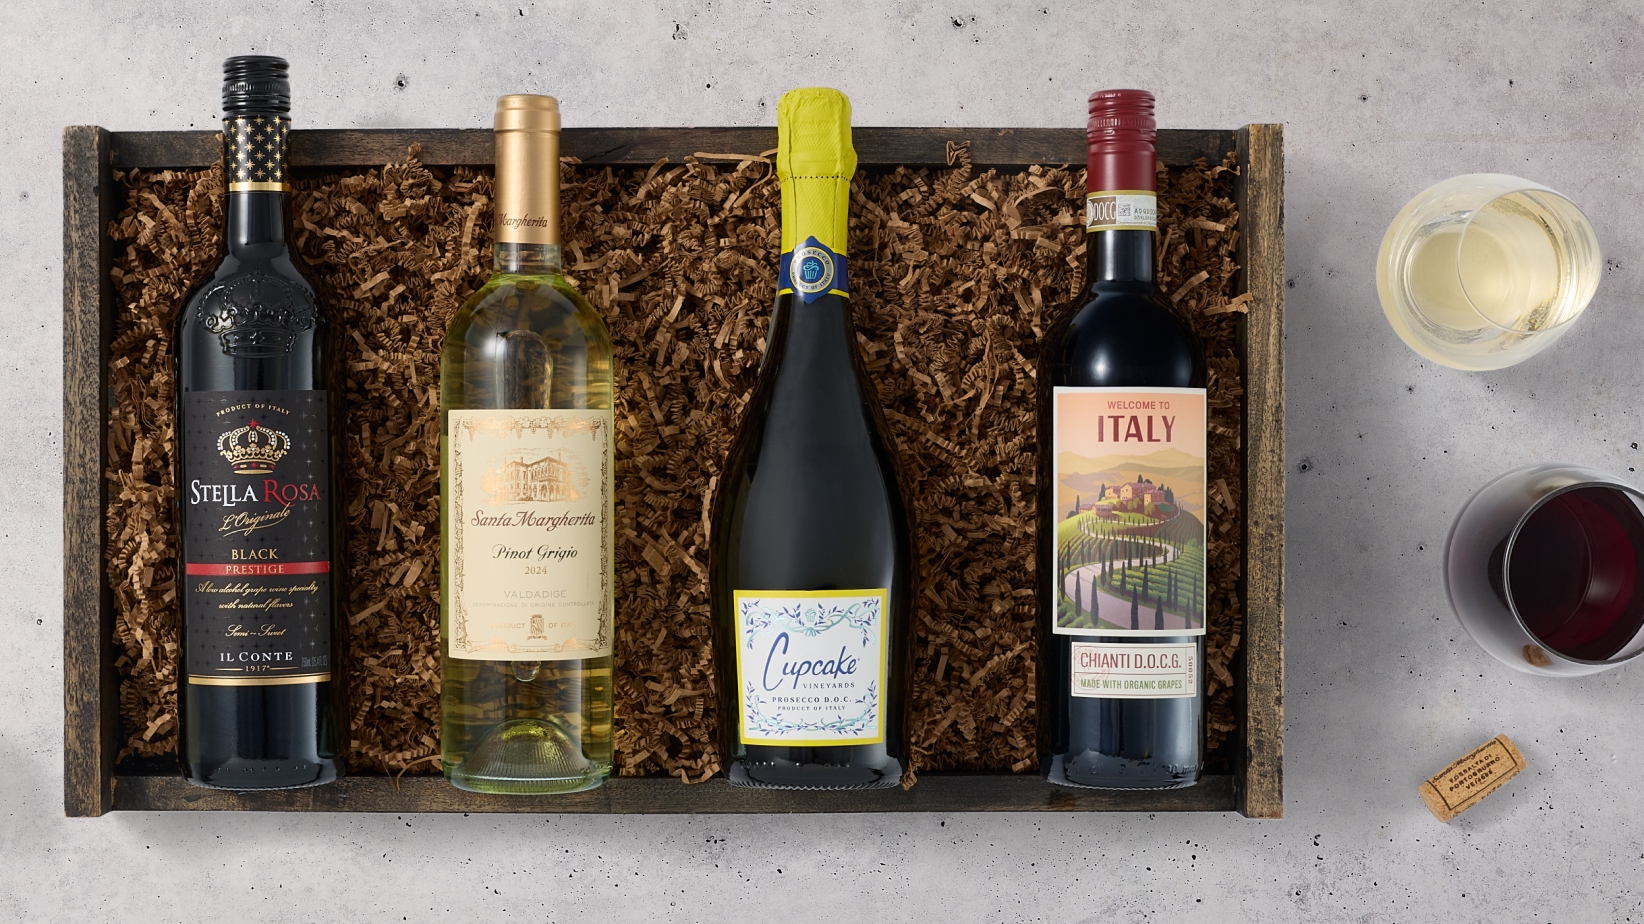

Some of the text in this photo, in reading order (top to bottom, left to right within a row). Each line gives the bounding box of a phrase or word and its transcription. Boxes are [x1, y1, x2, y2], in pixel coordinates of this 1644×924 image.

[497, 212, 548, 230] Margherita
[215, 403, 251, 417] PRODUCT
[268, 404, 290, 415] ITALY
[1107, 400, 1170, 410] WELCOME TO
[1098, 415, 1176, 443] ITALY
[190, 479, 321, 508] STELLA ROSA
[218, 502, 291, 537] L'Originale
[470, 509, 596, 531] Santa Margherita
[231, 548, 279, 560] BLACK
[491, 543, 578, 562] Pinot Grigio
[225, 564, 285, 575] PRESTIGE
[524, 565, 548, 575] 2024
[195, 580, 210, 593] A
[218, 582, 249, 593] alcohol
[242, 586, 267, 596] grape
[288, 580, 319, 595] specialty
[503, 589, 567, 599] VALDADIGE
[218, 598, 293, 612] with natural flavors
[560, 621, 578, 629] ITALY
[220, 651, 294, 662] IL CONTE
[762, 631, 857, 692] Cupcake
[1080, 652, 1182, 669] CHIANTI D.O.C.G.
[1080, 678, 1183, 689] MADE WITH ORGANIC GRAPES
[1483, 753, 1493, 761] DI
